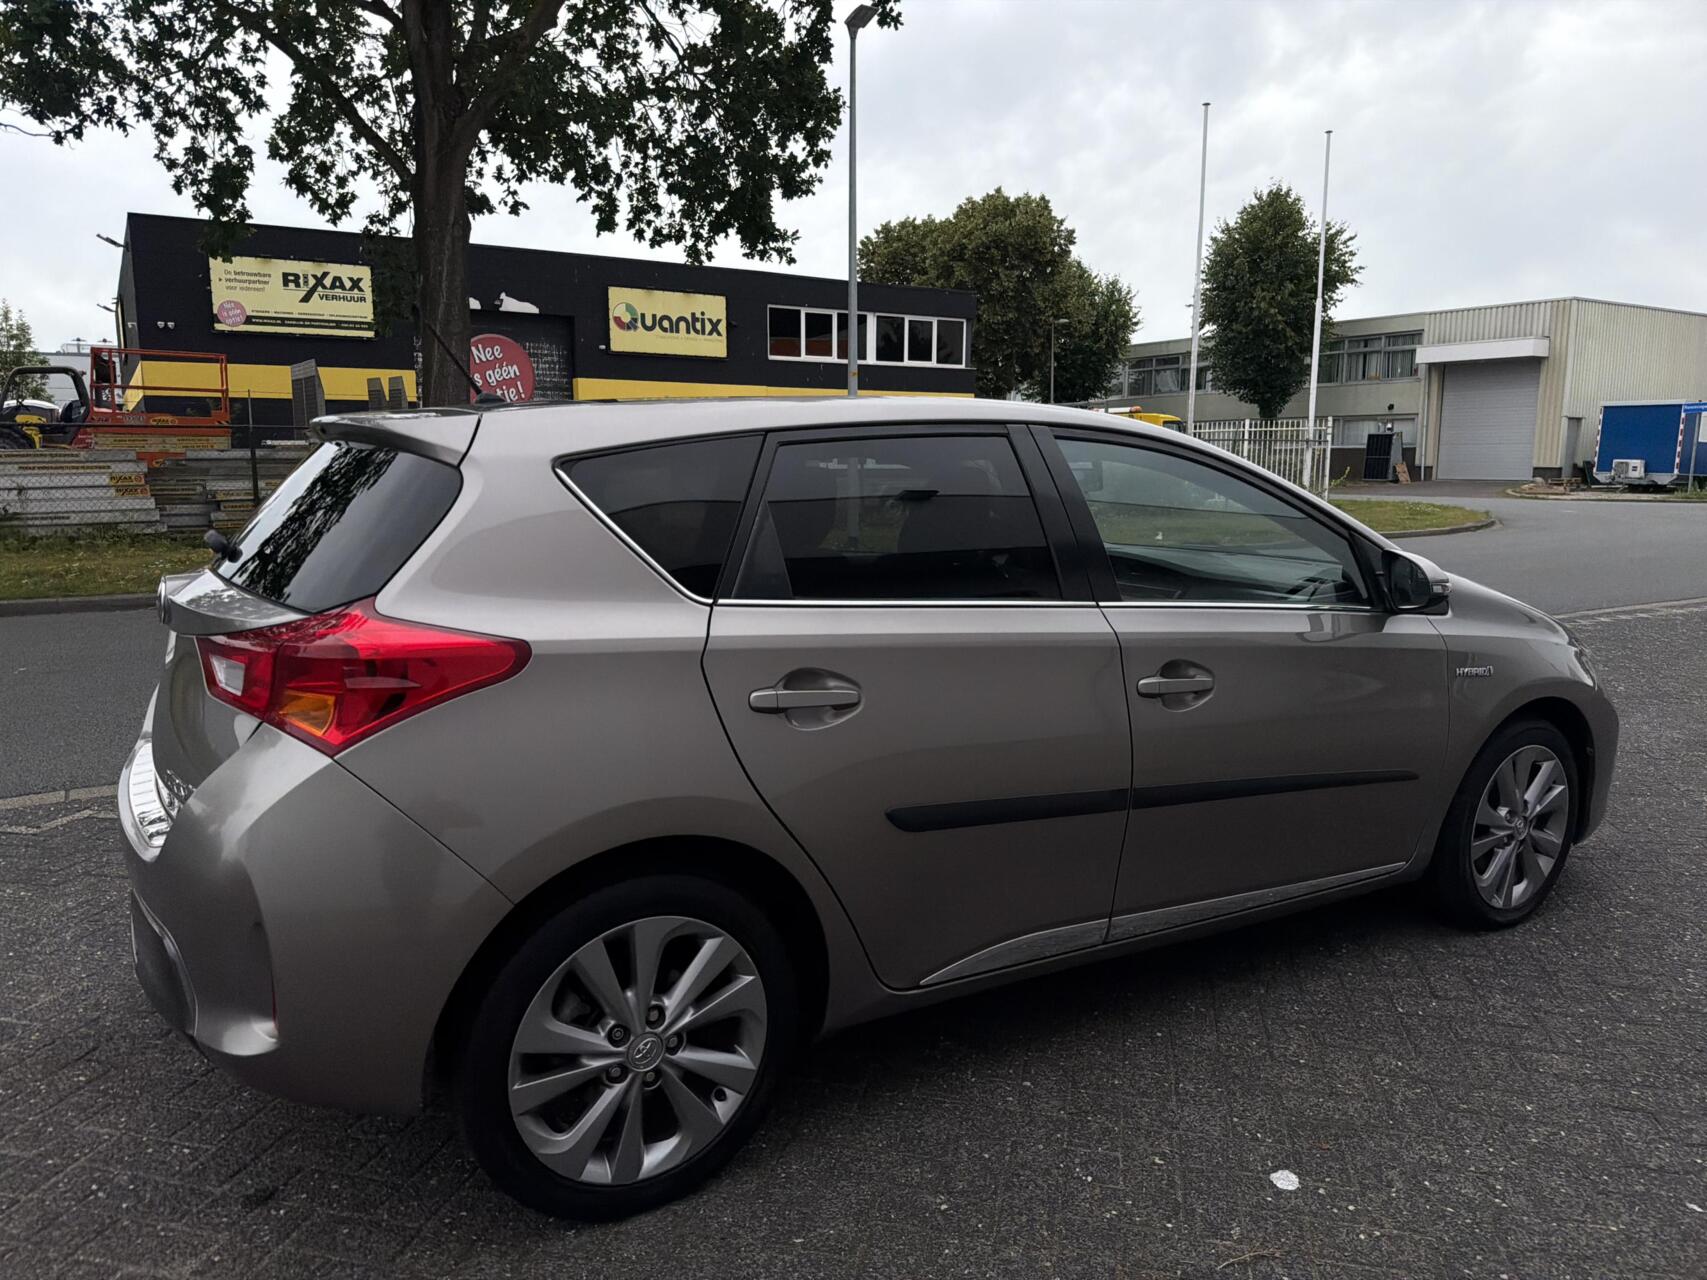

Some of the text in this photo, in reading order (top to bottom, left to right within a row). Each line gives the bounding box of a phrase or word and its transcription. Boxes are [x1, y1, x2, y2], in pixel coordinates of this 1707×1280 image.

[225, 277, 270, 285] verhuurpartner
[233, 270, 272, 278] betrouwbare
[318, 293, 367, 303] VERHUUR
[613, 302, 723, 337] Quantix
[471, 343, 503, 364] Nee
[486, 361, 520, 386] géén
[496, 381, 525, 402] tie!
[1456, 667, 1489, 677] HYBRID
